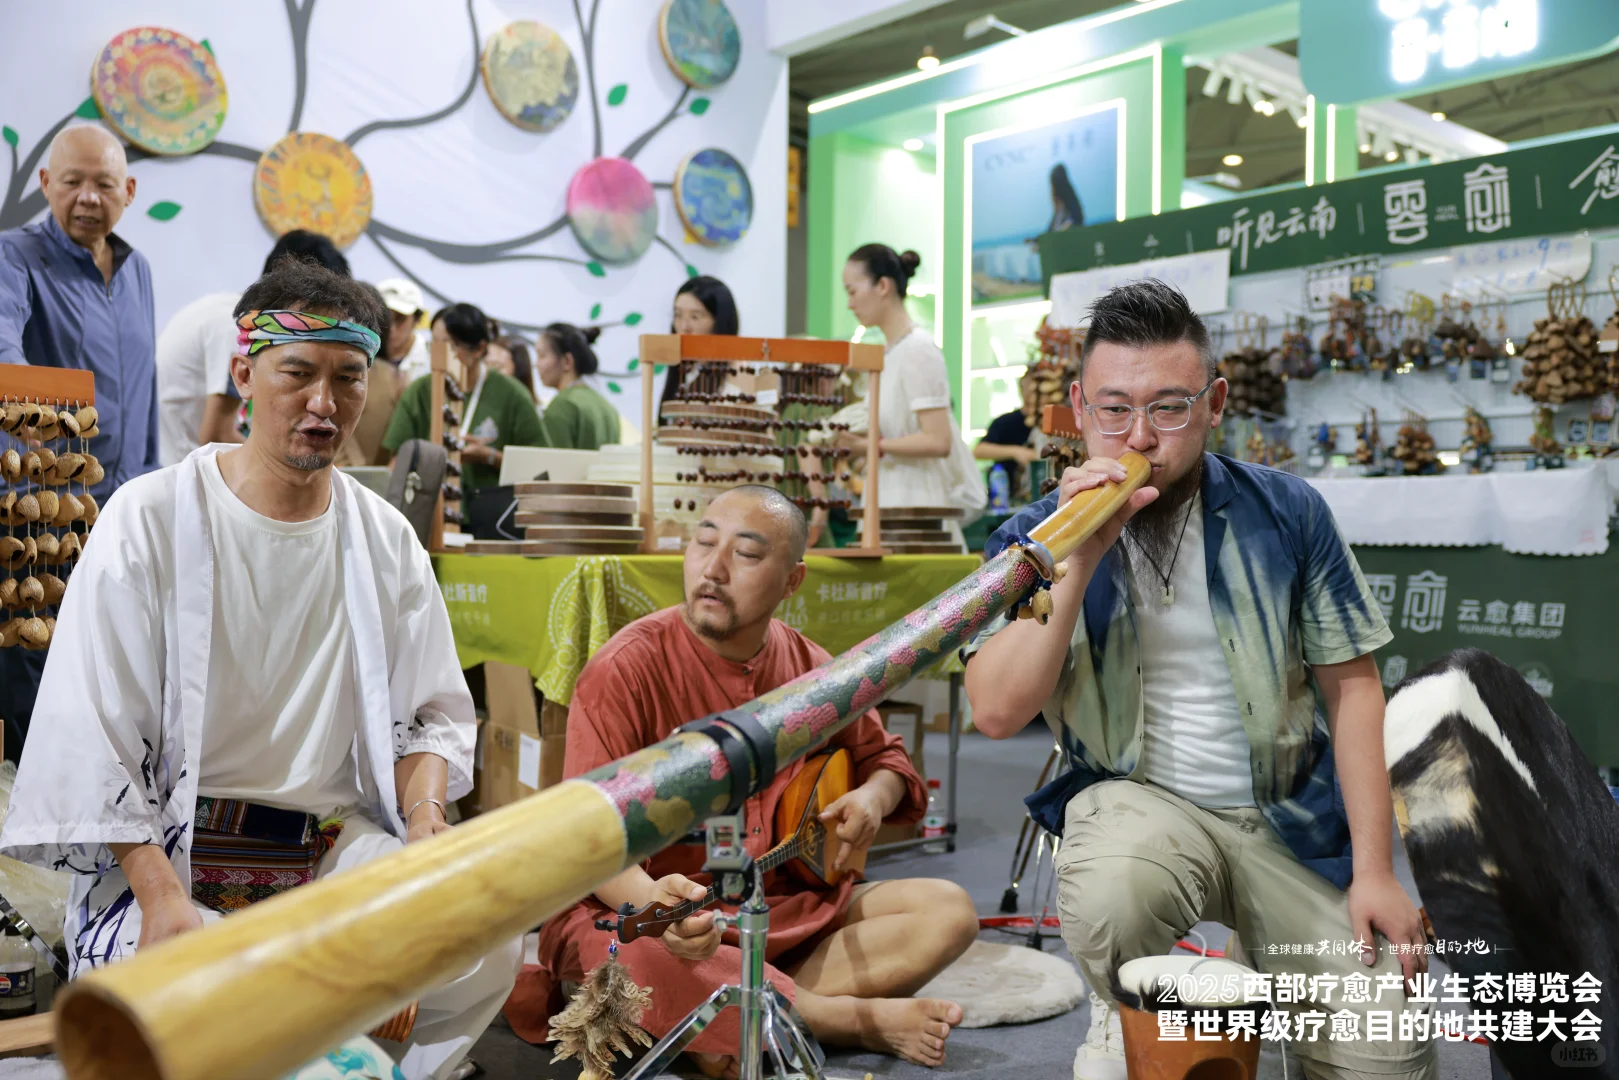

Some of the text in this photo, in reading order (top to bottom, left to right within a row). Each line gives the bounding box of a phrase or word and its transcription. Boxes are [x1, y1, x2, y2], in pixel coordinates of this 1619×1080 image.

[1217, 196, 1337, 270] 听见云南
[1457, 599, 1567, 628] 云愈集团
[1516, 625, 1563, 639] GROUP
